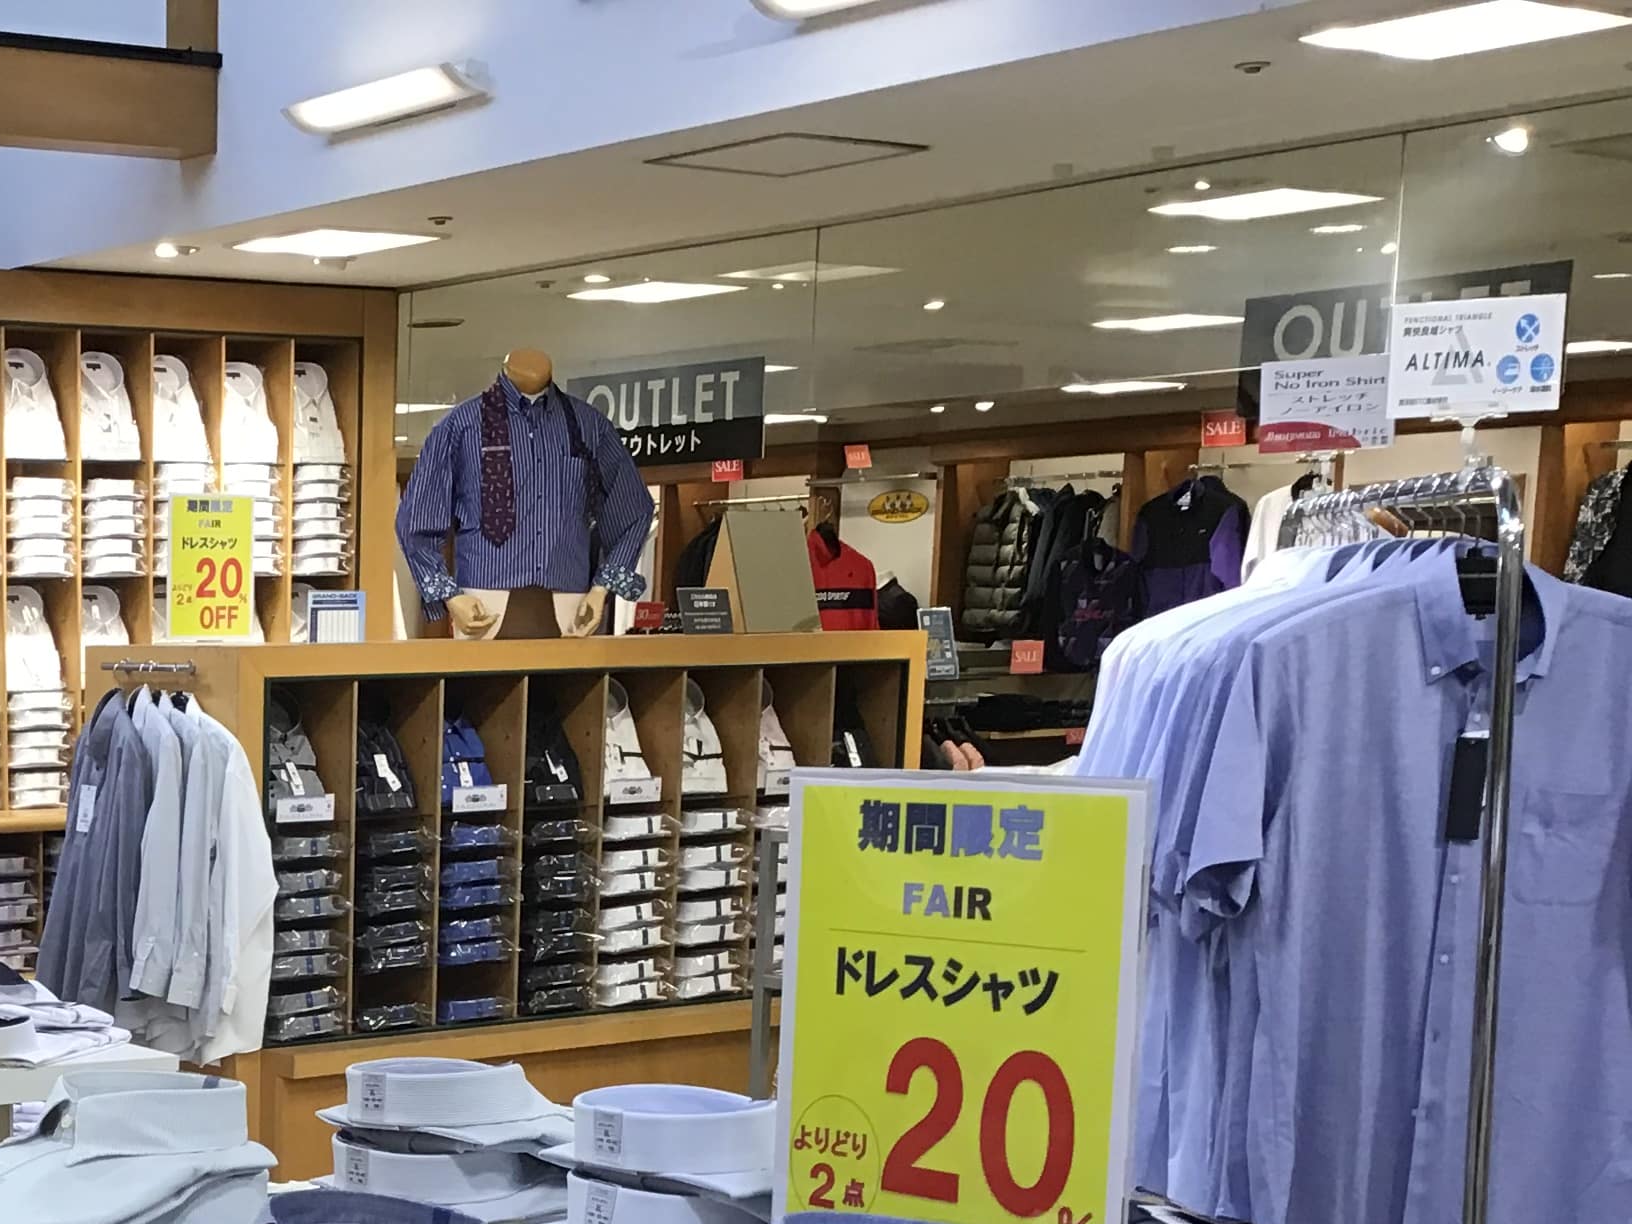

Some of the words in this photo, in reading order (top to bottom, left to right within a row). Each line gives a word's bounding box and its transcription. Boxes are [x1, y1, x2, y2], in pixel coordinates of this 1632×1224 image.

[1405, 350, 1485, 371] ALTIMA
[586, 371, 740, 431] OUTLET
[1206, 421, 1241, 435] SALE
[715, 460, 740, 472] SALE
[182, 536, 238, 550] ドレスシャツ
[200, 606, 239, 629] OFF
[858, 799, 1046, 861] 期間限定
[903, 883, 992, 920] FAIR
[835, 947, 1059, 1015] ドレスシャツ
[793, 1125, 867, 1159] よりどり
